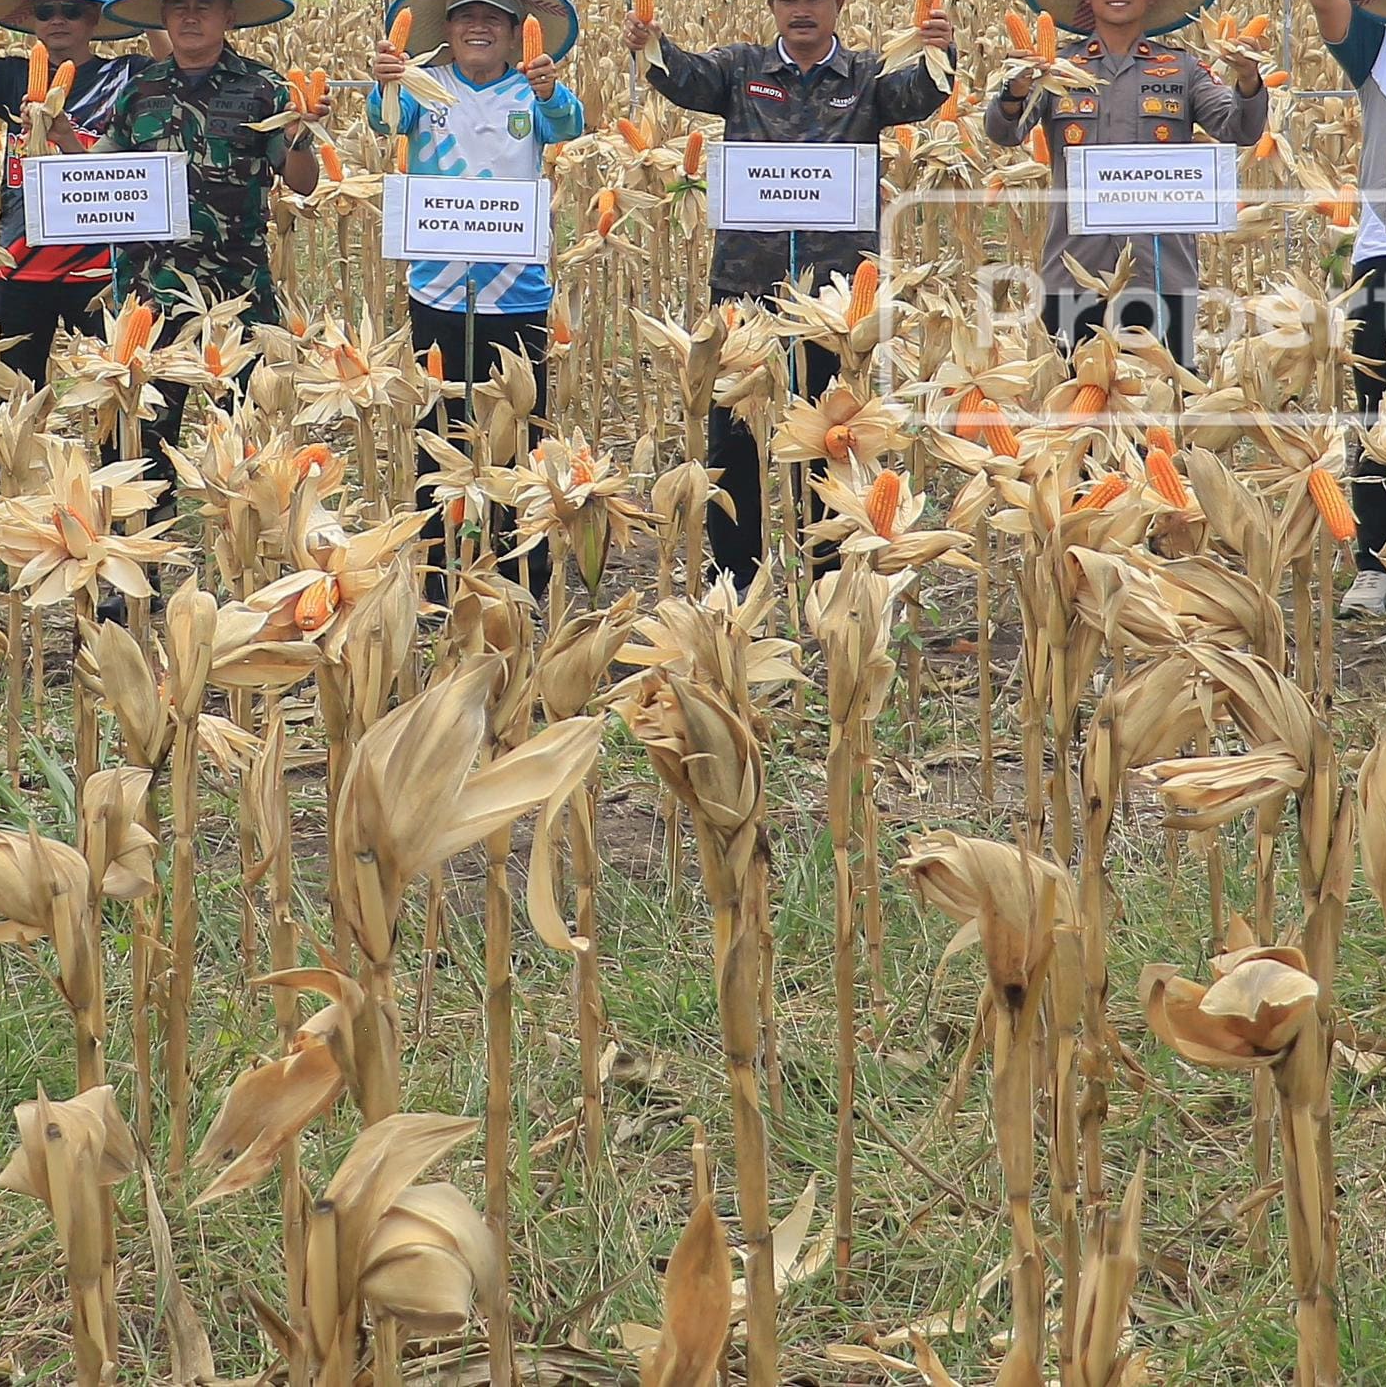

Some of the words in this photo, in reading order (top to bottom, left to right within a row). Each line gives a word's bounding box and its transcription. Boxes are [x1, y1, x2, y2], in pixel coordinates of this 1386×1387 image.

[750, 86, 783, 98] WALIKOTA
[1141, 84, 1183, 95] POLRI
[62, 169, 145, 181] KOMANDAN
[748, 168, 784, 178] WALI
[791, 168, 832, 179] KOTA
[1099, 169, 1202, 181] WAKAPOLRES
[62, 192, 109, 203] KODIM
[114, 190, 148, 201] 0803
[760, 190, 819, 200] MADIUN
[1098, 190, 1158, 204] MADIUN
[1162, 189, 1206, 203] KOTA
[425, 198, 474, 209] KETUA
[480, 200, 519, 211] DPRD
[77, 212, 134, 223] MADIUN
[419, 220, 459, 230] KOTA
[465, 221, 523, 232] MADIUN
